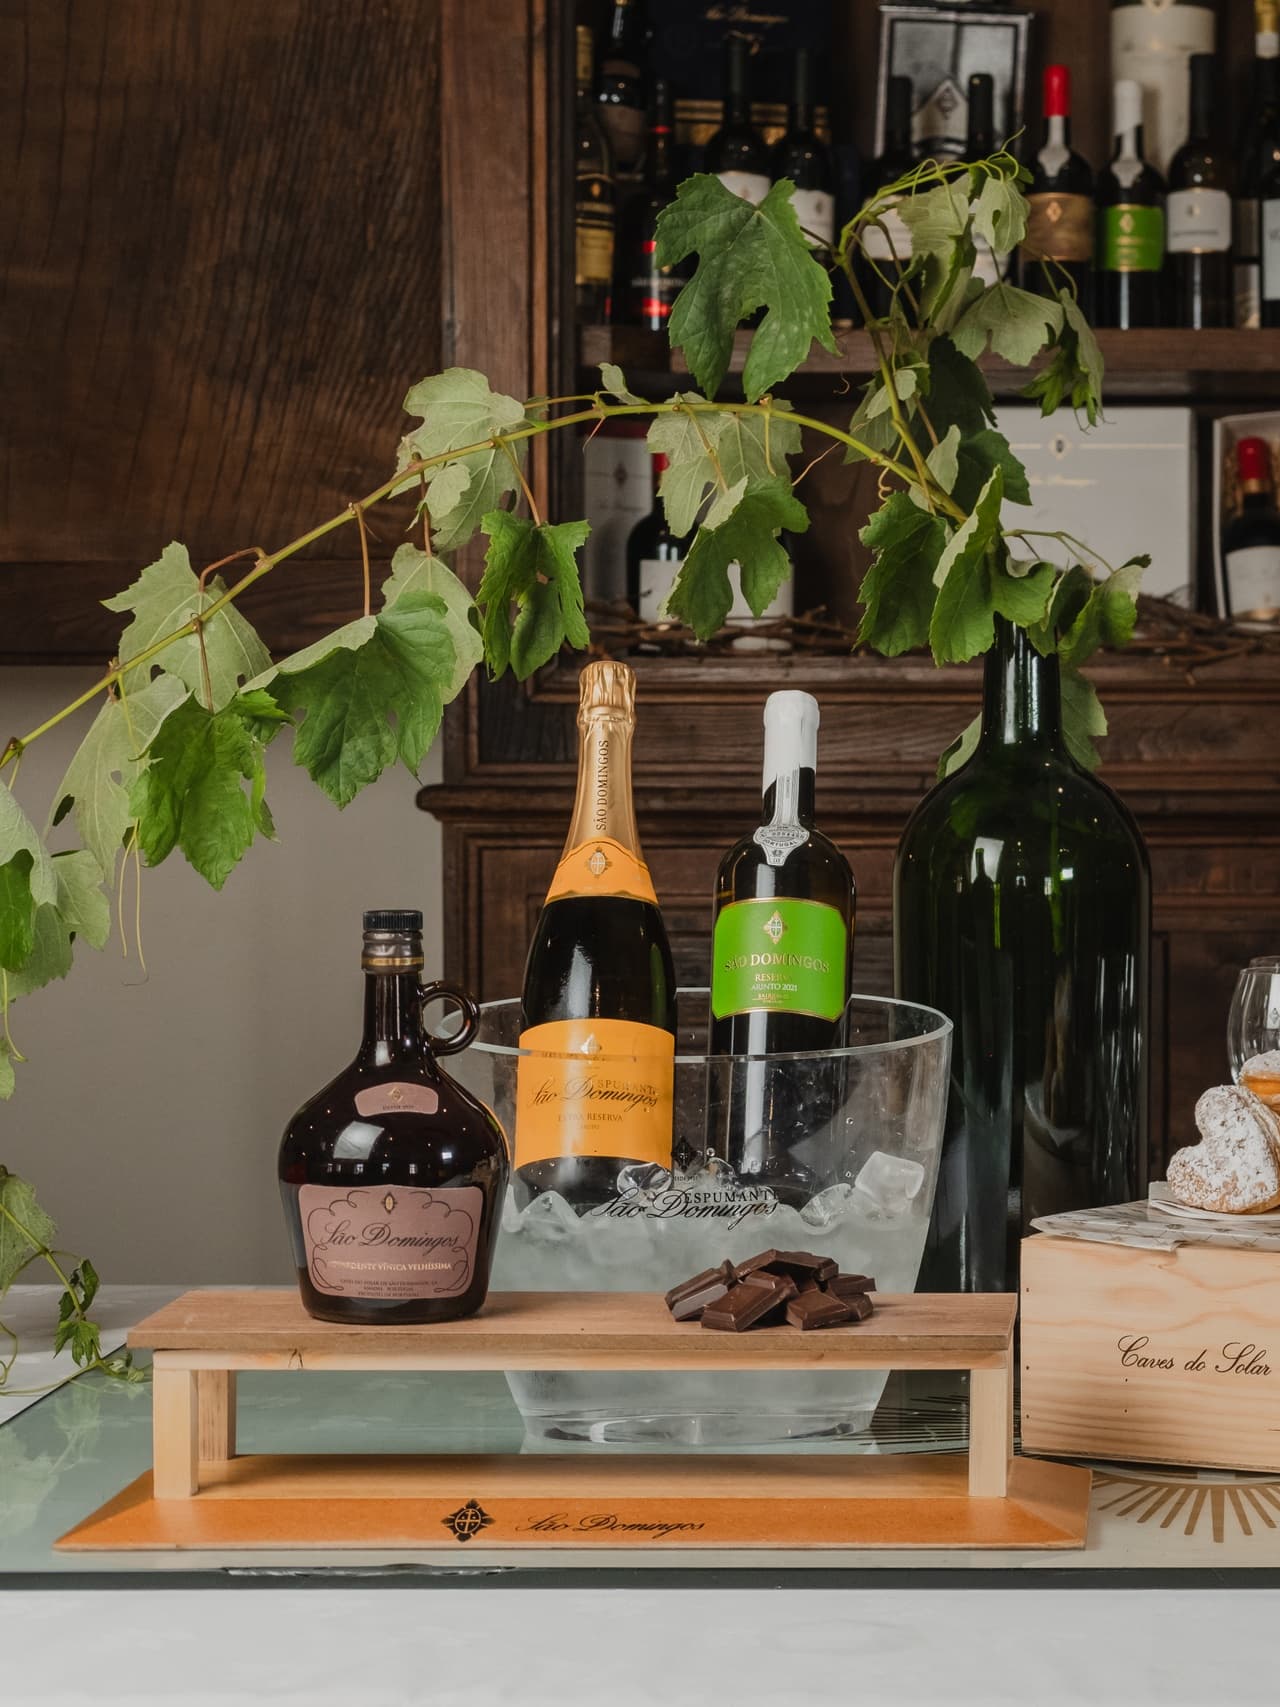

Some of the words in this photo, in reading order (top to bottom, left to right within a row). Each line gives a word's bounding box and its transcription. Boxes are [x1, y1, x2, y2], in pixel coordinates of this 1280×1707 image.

[597, 740, 609, 806] DOMINGOS
[751, 952, 830, 973] DOMINGOS
[560, 1074, 658, 1113] Domingos
[587, 1113, 623, 1122] RESERVA
[592, 1187, 648, 1218] São
[647, 1187, 780, 1232] Domingos
[321, 1219, 357, 1248] São
[359, 1222, 460, 1256] Domingos
[1117, 1335, 1175, 1370] Caves
[1215, 1341, 1272, 1376] Solar
[572, 1512, 706, 1540] Domingos
